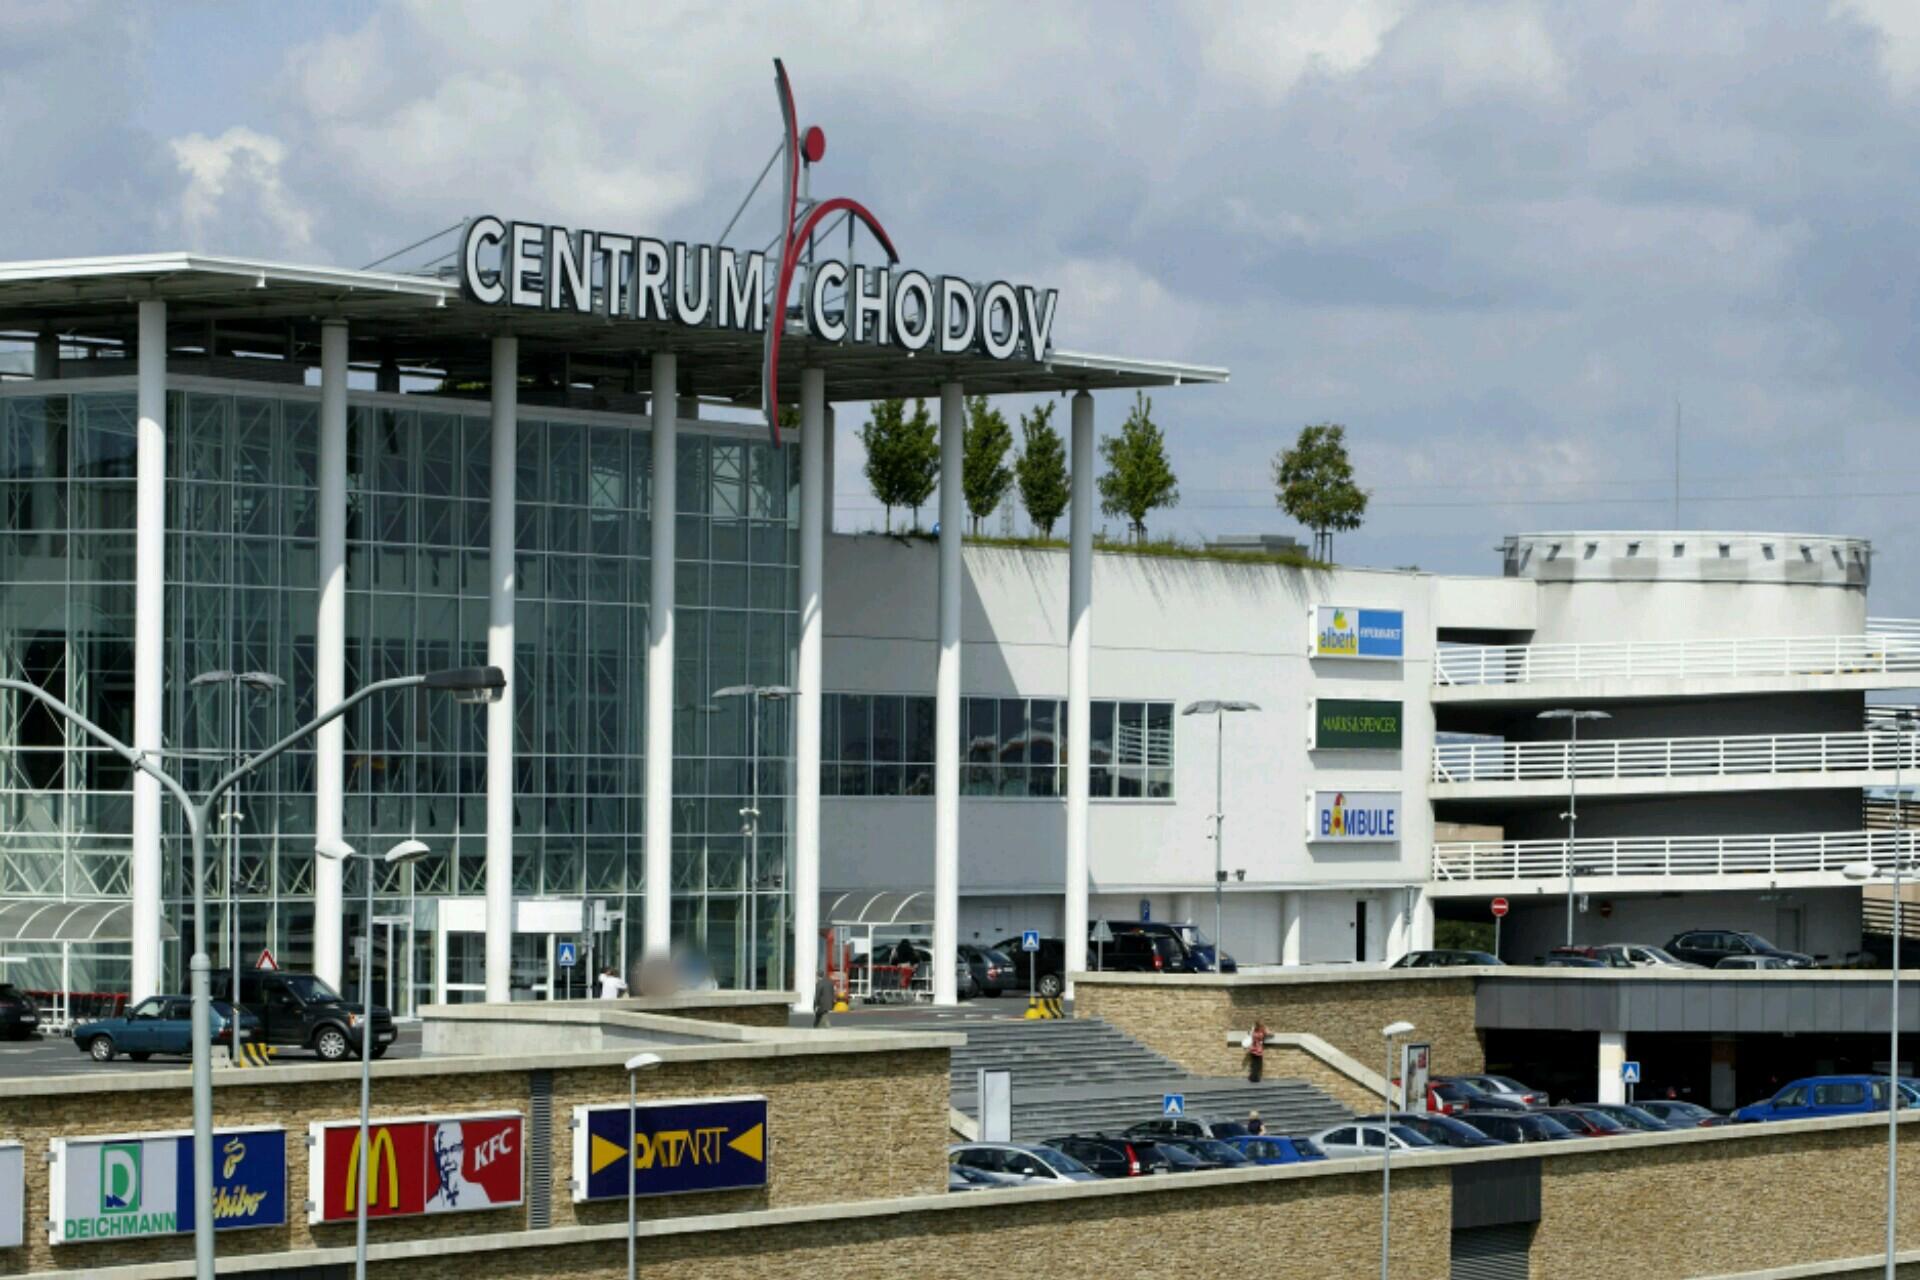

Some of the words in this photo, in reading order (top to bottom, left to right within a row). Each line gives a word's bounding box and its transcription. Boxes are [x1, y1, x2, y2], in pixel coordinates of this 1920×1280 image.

[462, 214, 765, 333] CENTRUM
[808, 258, 1058, 364] CHODOV
[1320, 626, 1356, 649] albert
[1321, 806, 1394, 837] BAMBULE
[474, 1127, 513, 1172] KFC
[65, 1211, 177, 1240] DEICHMANN
